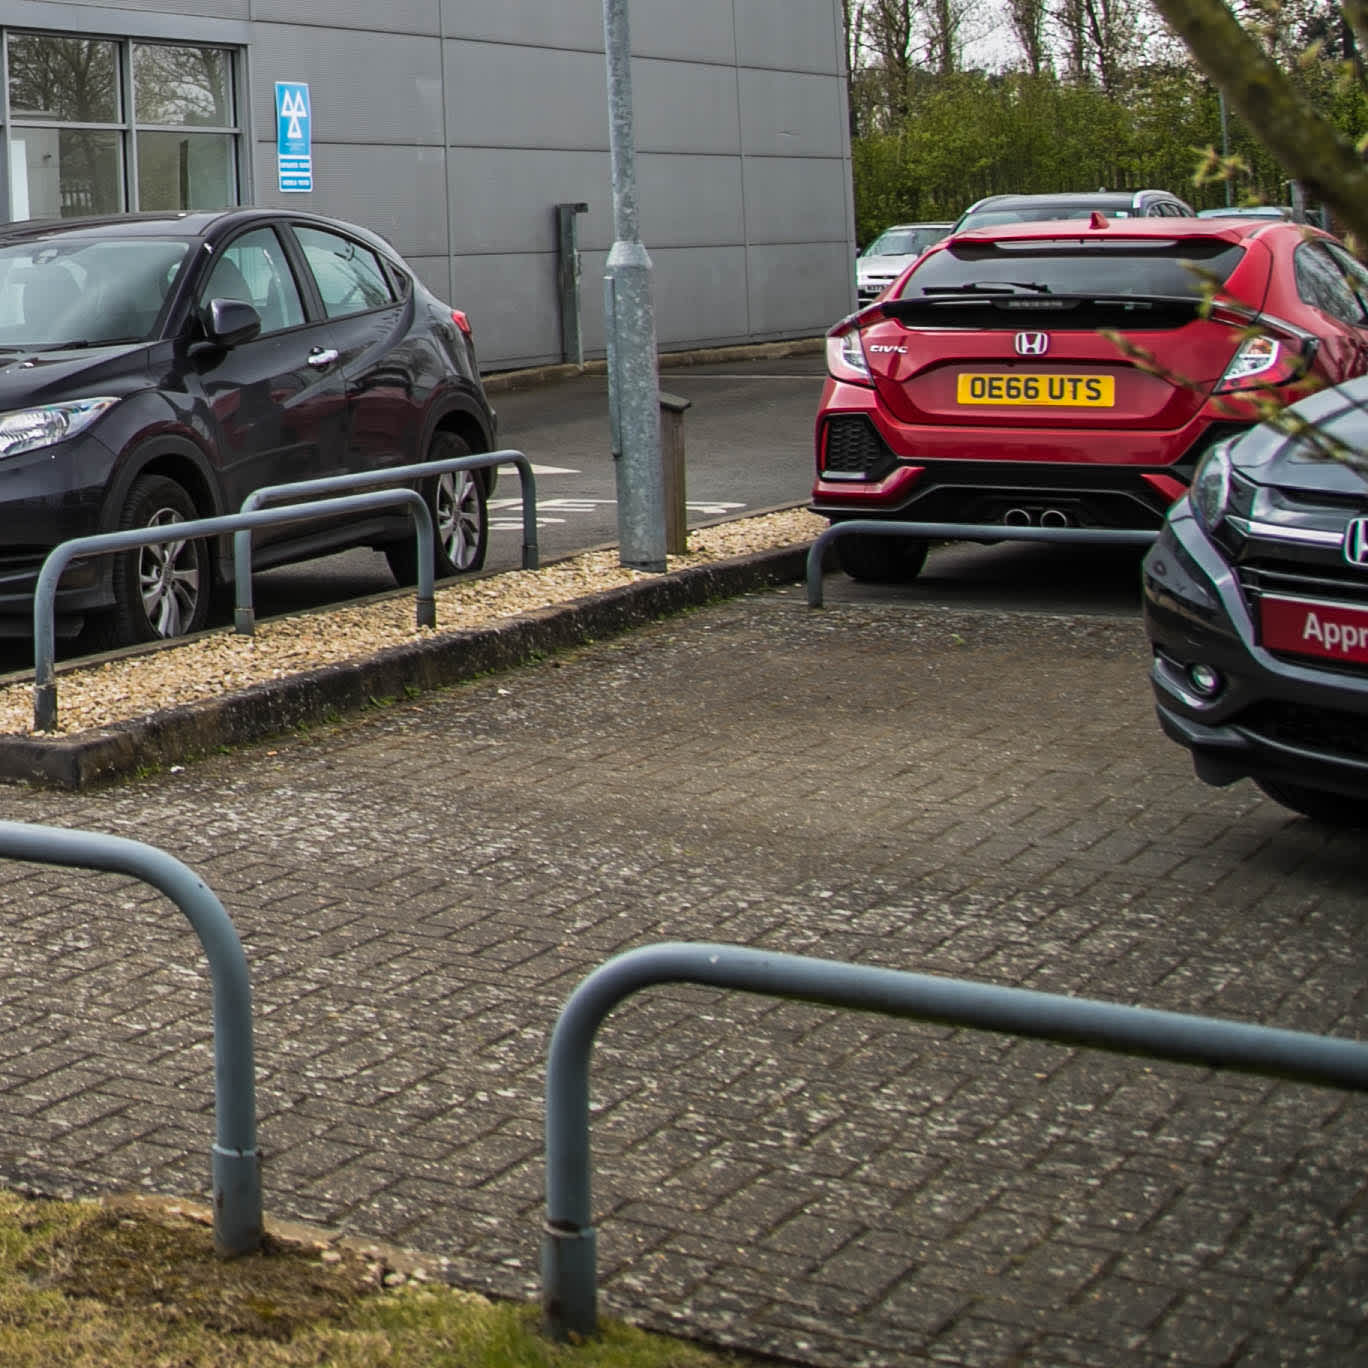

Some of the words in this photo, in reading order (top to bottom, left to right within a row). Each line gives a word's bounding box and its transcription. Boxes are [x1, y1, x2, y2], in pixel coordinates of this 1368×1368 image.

[870, 344, 909, 354] CIVIC
[970, 376, 1040, 400] OE66
[1047, 378, 1102, 401] UTS
[1302, 612, 1368, 652] Appr
